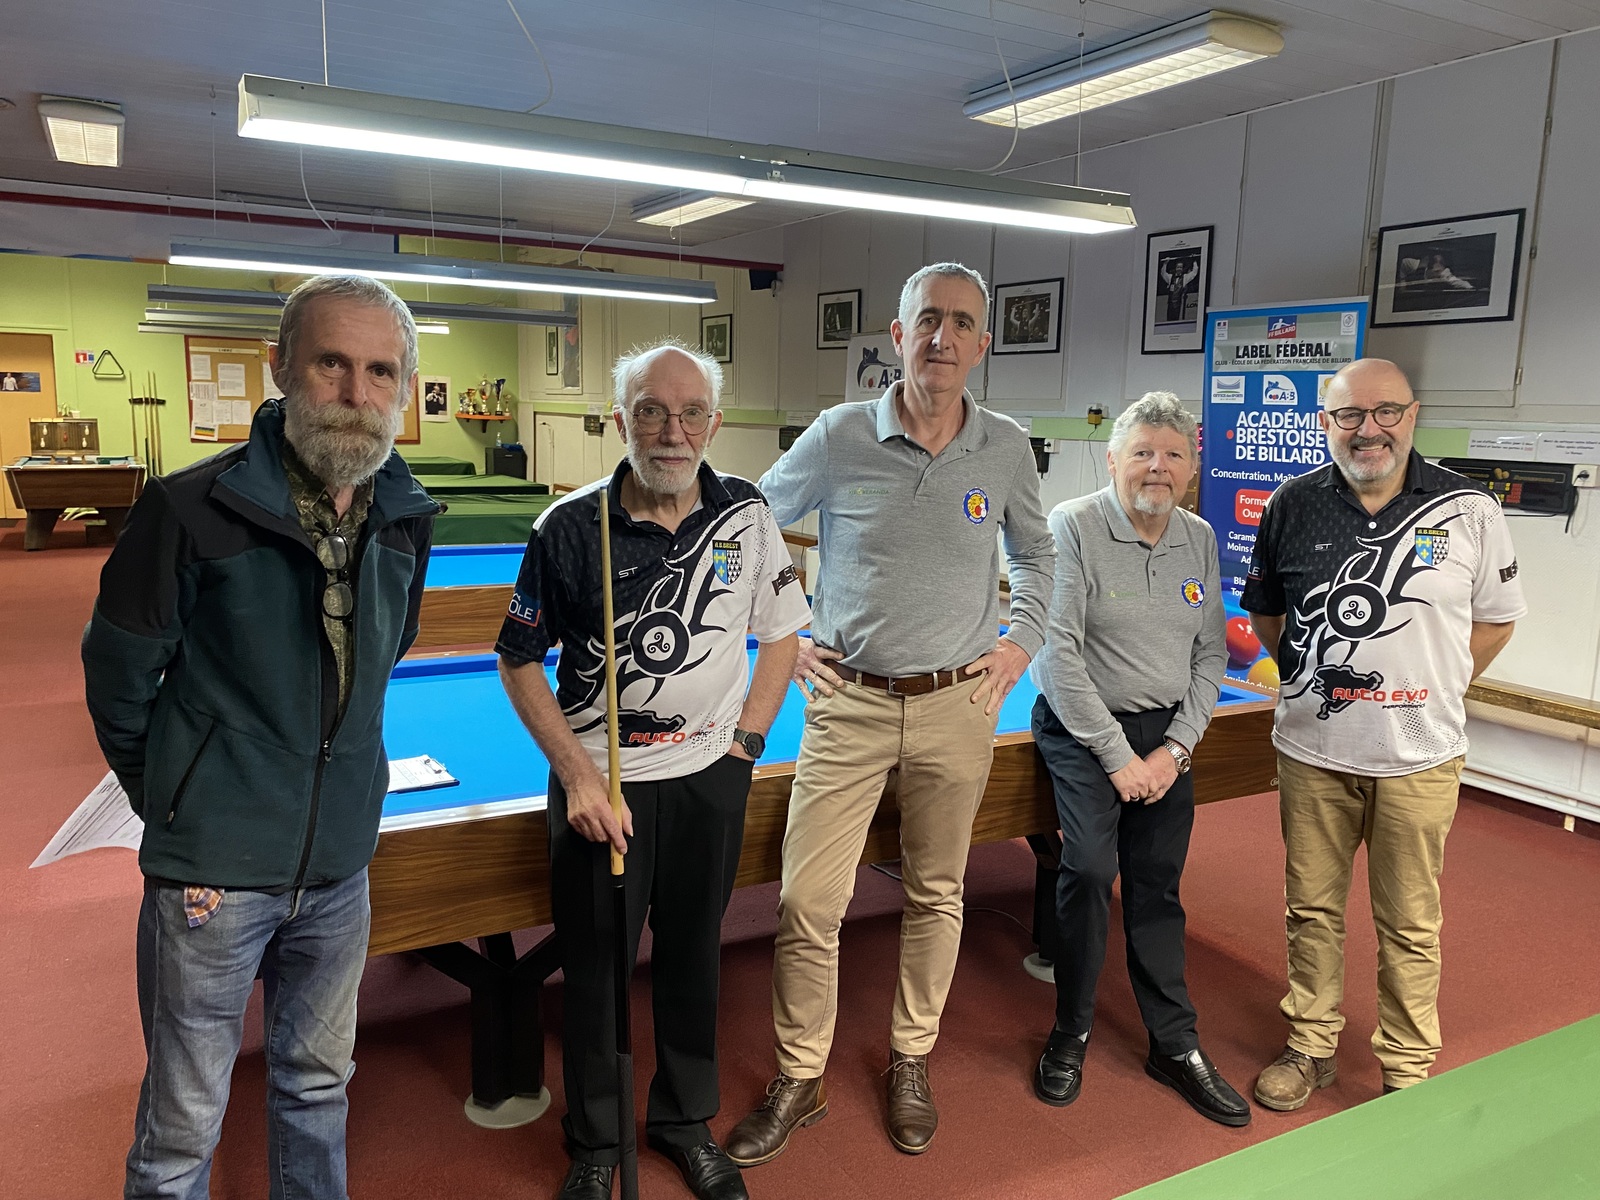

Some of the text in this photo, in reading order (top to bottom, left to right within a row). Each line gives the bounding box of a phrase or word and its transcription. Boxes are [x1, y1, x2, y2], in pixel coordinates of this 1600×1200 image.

[1235, 340, 1332, 359] LABEL FÉDÉRAL
[1231, 358, 1246, 366] ÉCOLE
[1292, 358, 1321, 366] FRANÇAISE
[1236, 427, 1326, 447] BRESTOISE
[1235, 445, 1326, 465] DE BILLARD
[1210, 468, 1273, 482] Concentration.
[1227, 542, 1249, 553] Moins
[618, 566, 639, 579] ST
[1391, 688, 1429, 702] EVO
